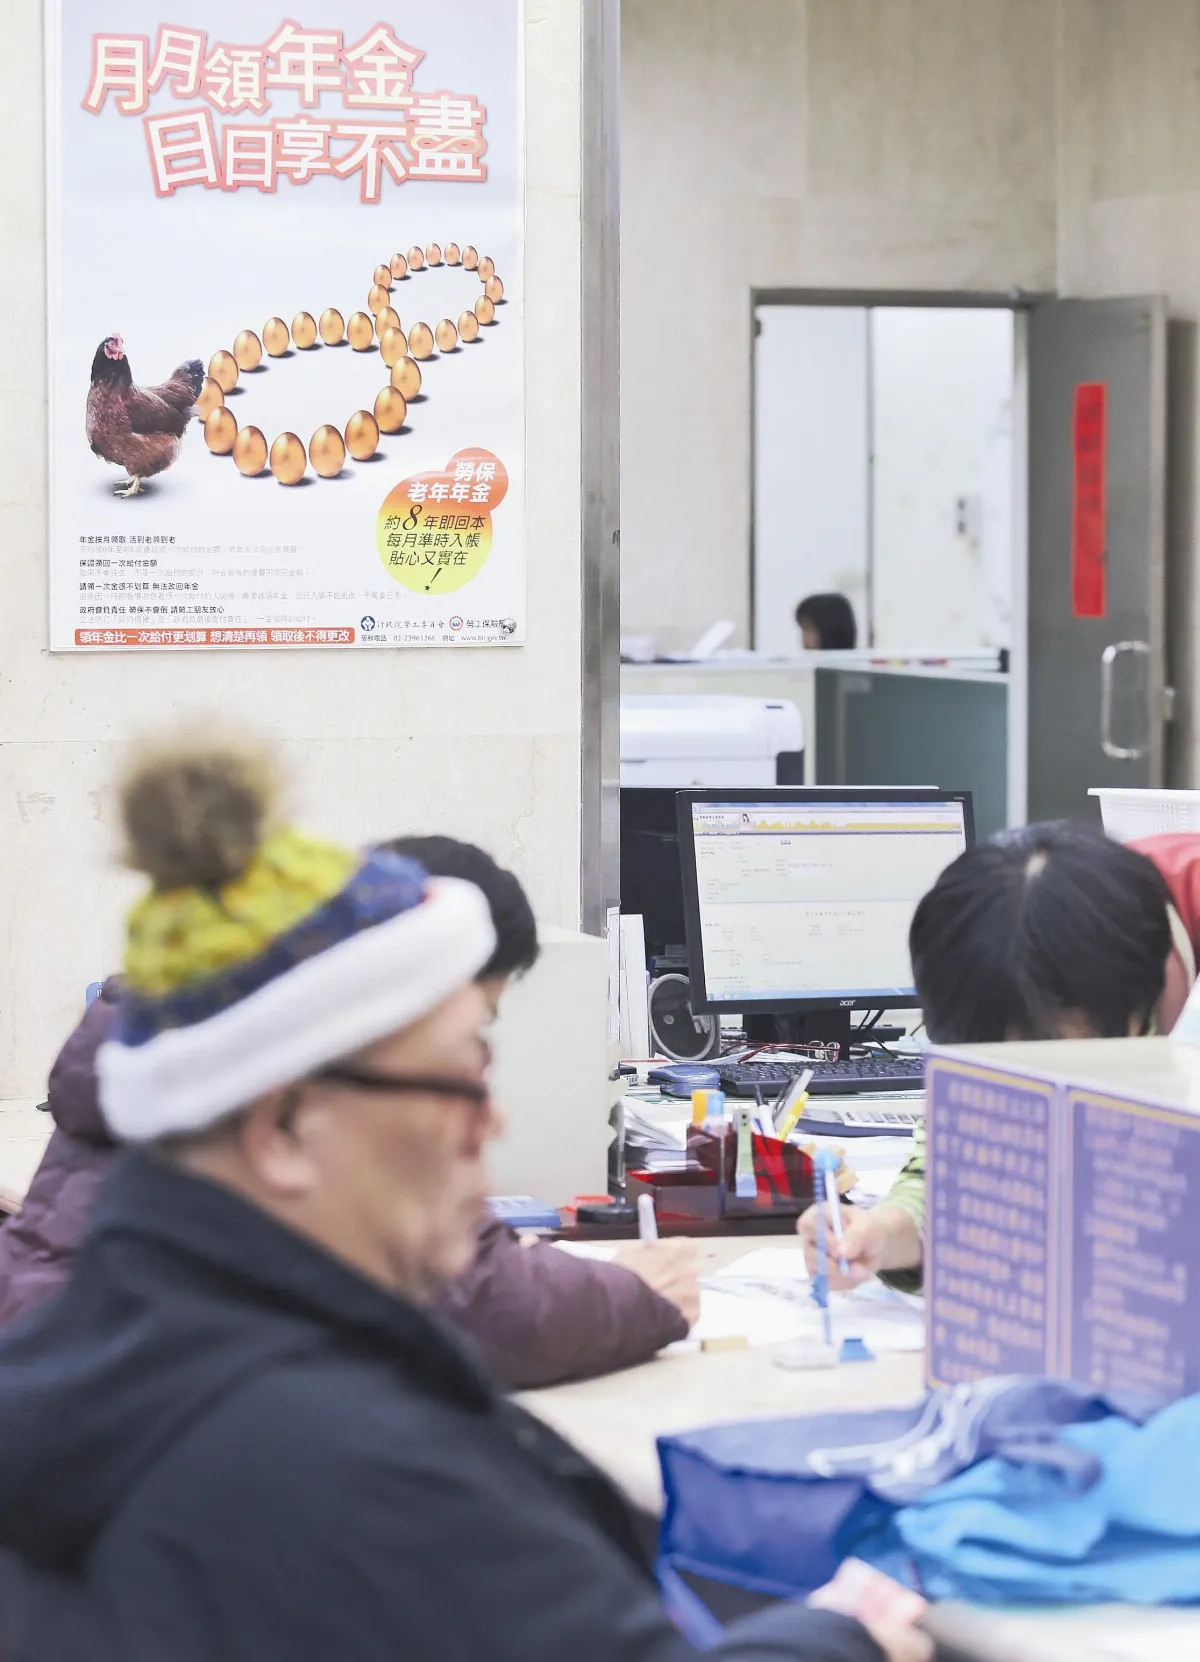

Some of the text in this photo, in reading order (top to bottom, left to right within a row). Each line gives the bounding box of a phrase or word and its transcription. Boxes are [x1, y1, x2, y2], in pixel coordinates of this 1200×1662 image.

[84, 20, 422, 113] 月月領年金
[146, 92, 485, 201] 日日享不盡
[454, 462, 496, 482] 勞保
[407, 482, 492, 503] 老年年金
[384, 505, 486, 531] 約8年即回本
[386, 533, 481, 549] 每月準時入帳
[389, 551, 468, 566] 貼心又實在
[79, 630, 207, 644] 領年金比一次給付更划算
[270, 630, 350, 643] 領取後不得更改
[839, 999, 856, 1007] acer
